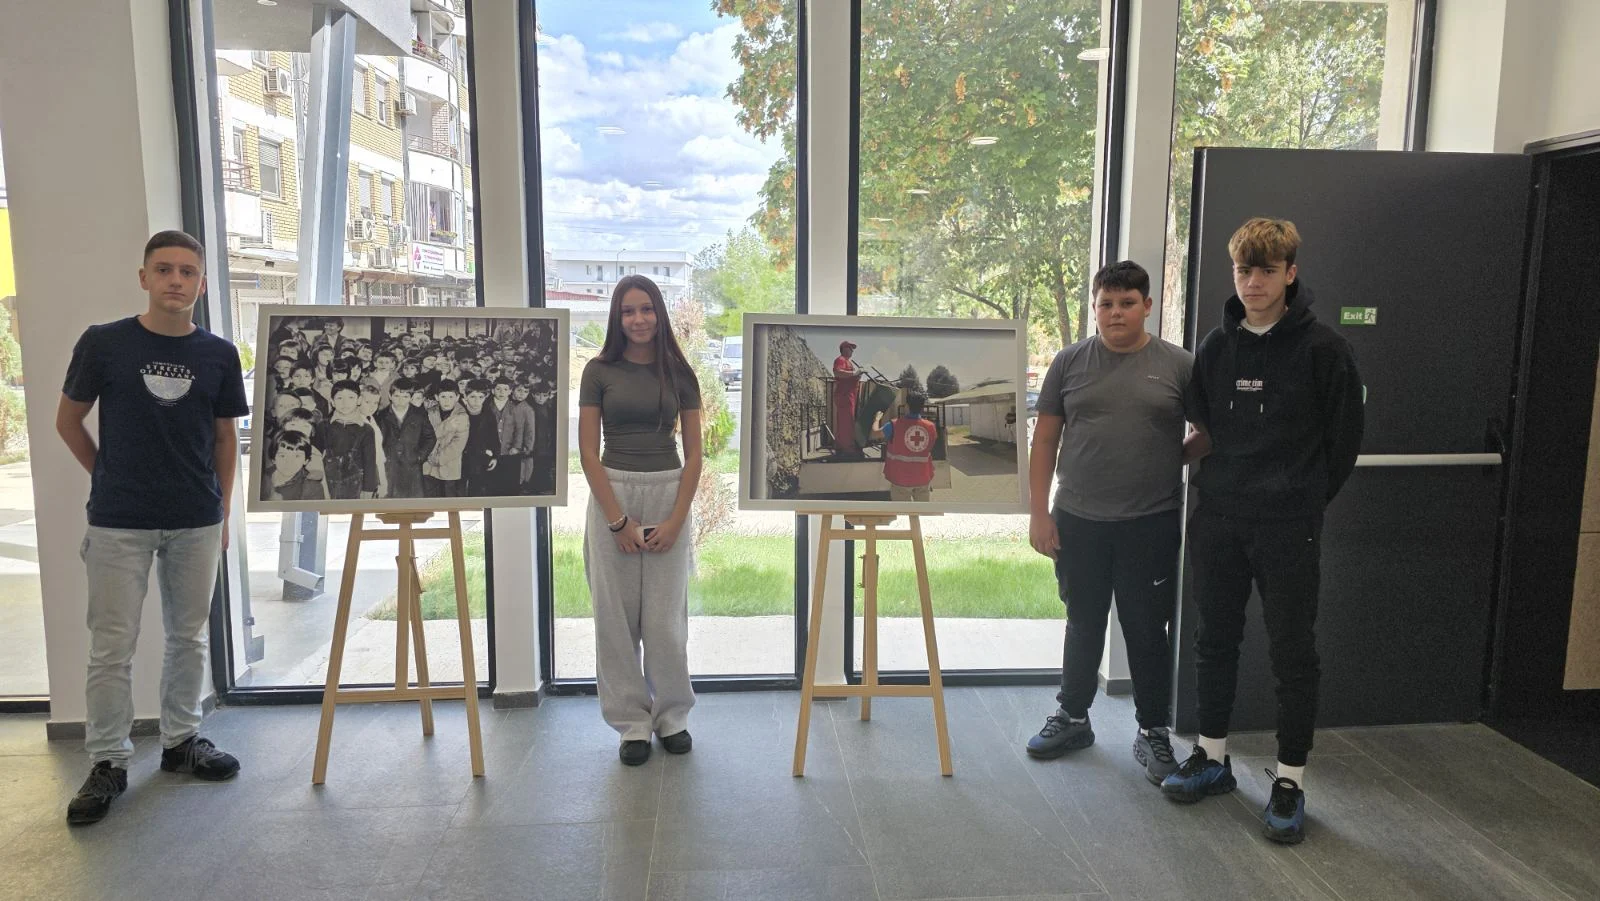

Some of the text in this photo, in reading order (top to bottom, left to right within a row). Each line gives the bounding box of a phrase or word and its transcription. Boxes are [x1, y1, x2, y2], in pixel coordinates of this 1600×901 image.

[1343, 311, 1363, 320] Exit
[146, 364, 191, 375] STREETS
[156, 370, 196, 380] HAVANA
